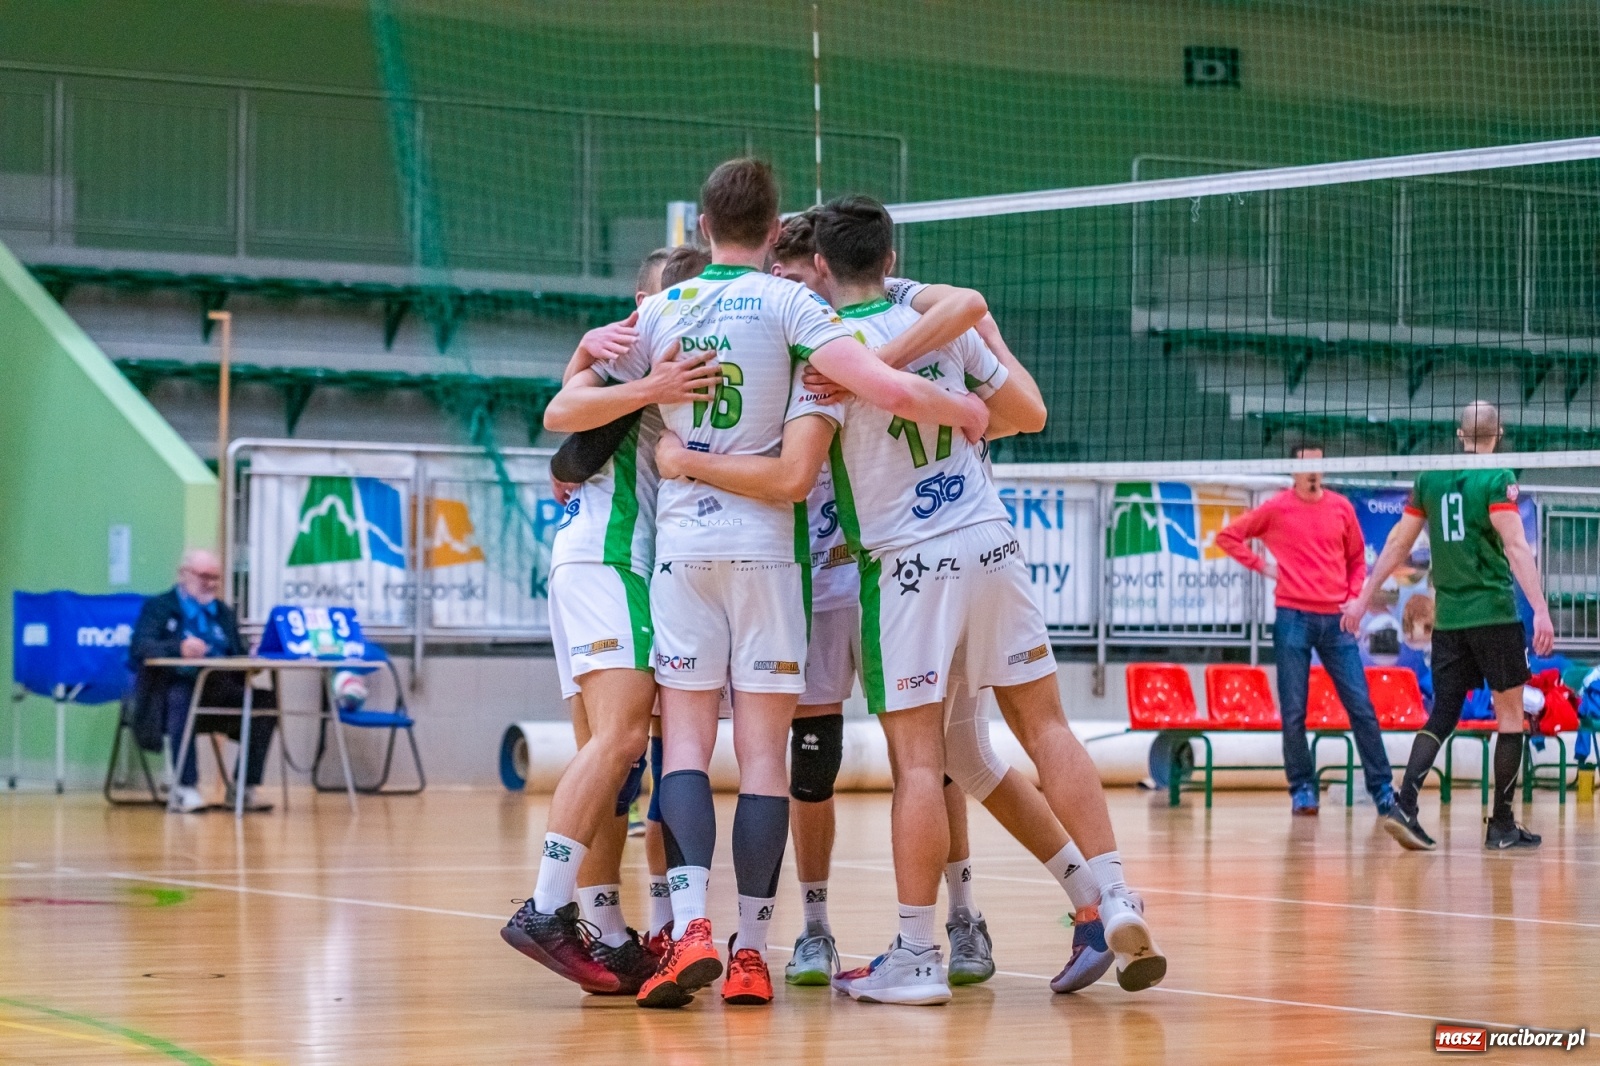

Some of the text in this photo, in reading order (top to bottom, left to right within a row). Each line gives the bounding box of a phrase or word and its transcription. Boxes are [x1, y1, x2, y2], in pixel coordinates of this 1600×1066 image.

[1193, 59, 1227, 81] D
[681, 335, 732, 352] DUDA
[911, 361, 946, 381] EK
[692, 361, 743, 430] 16
[680, 518, 743, 528] STILMAR
[1441, 493, 1466, 542] 13
[287, 610, 351, 638] 9 3
